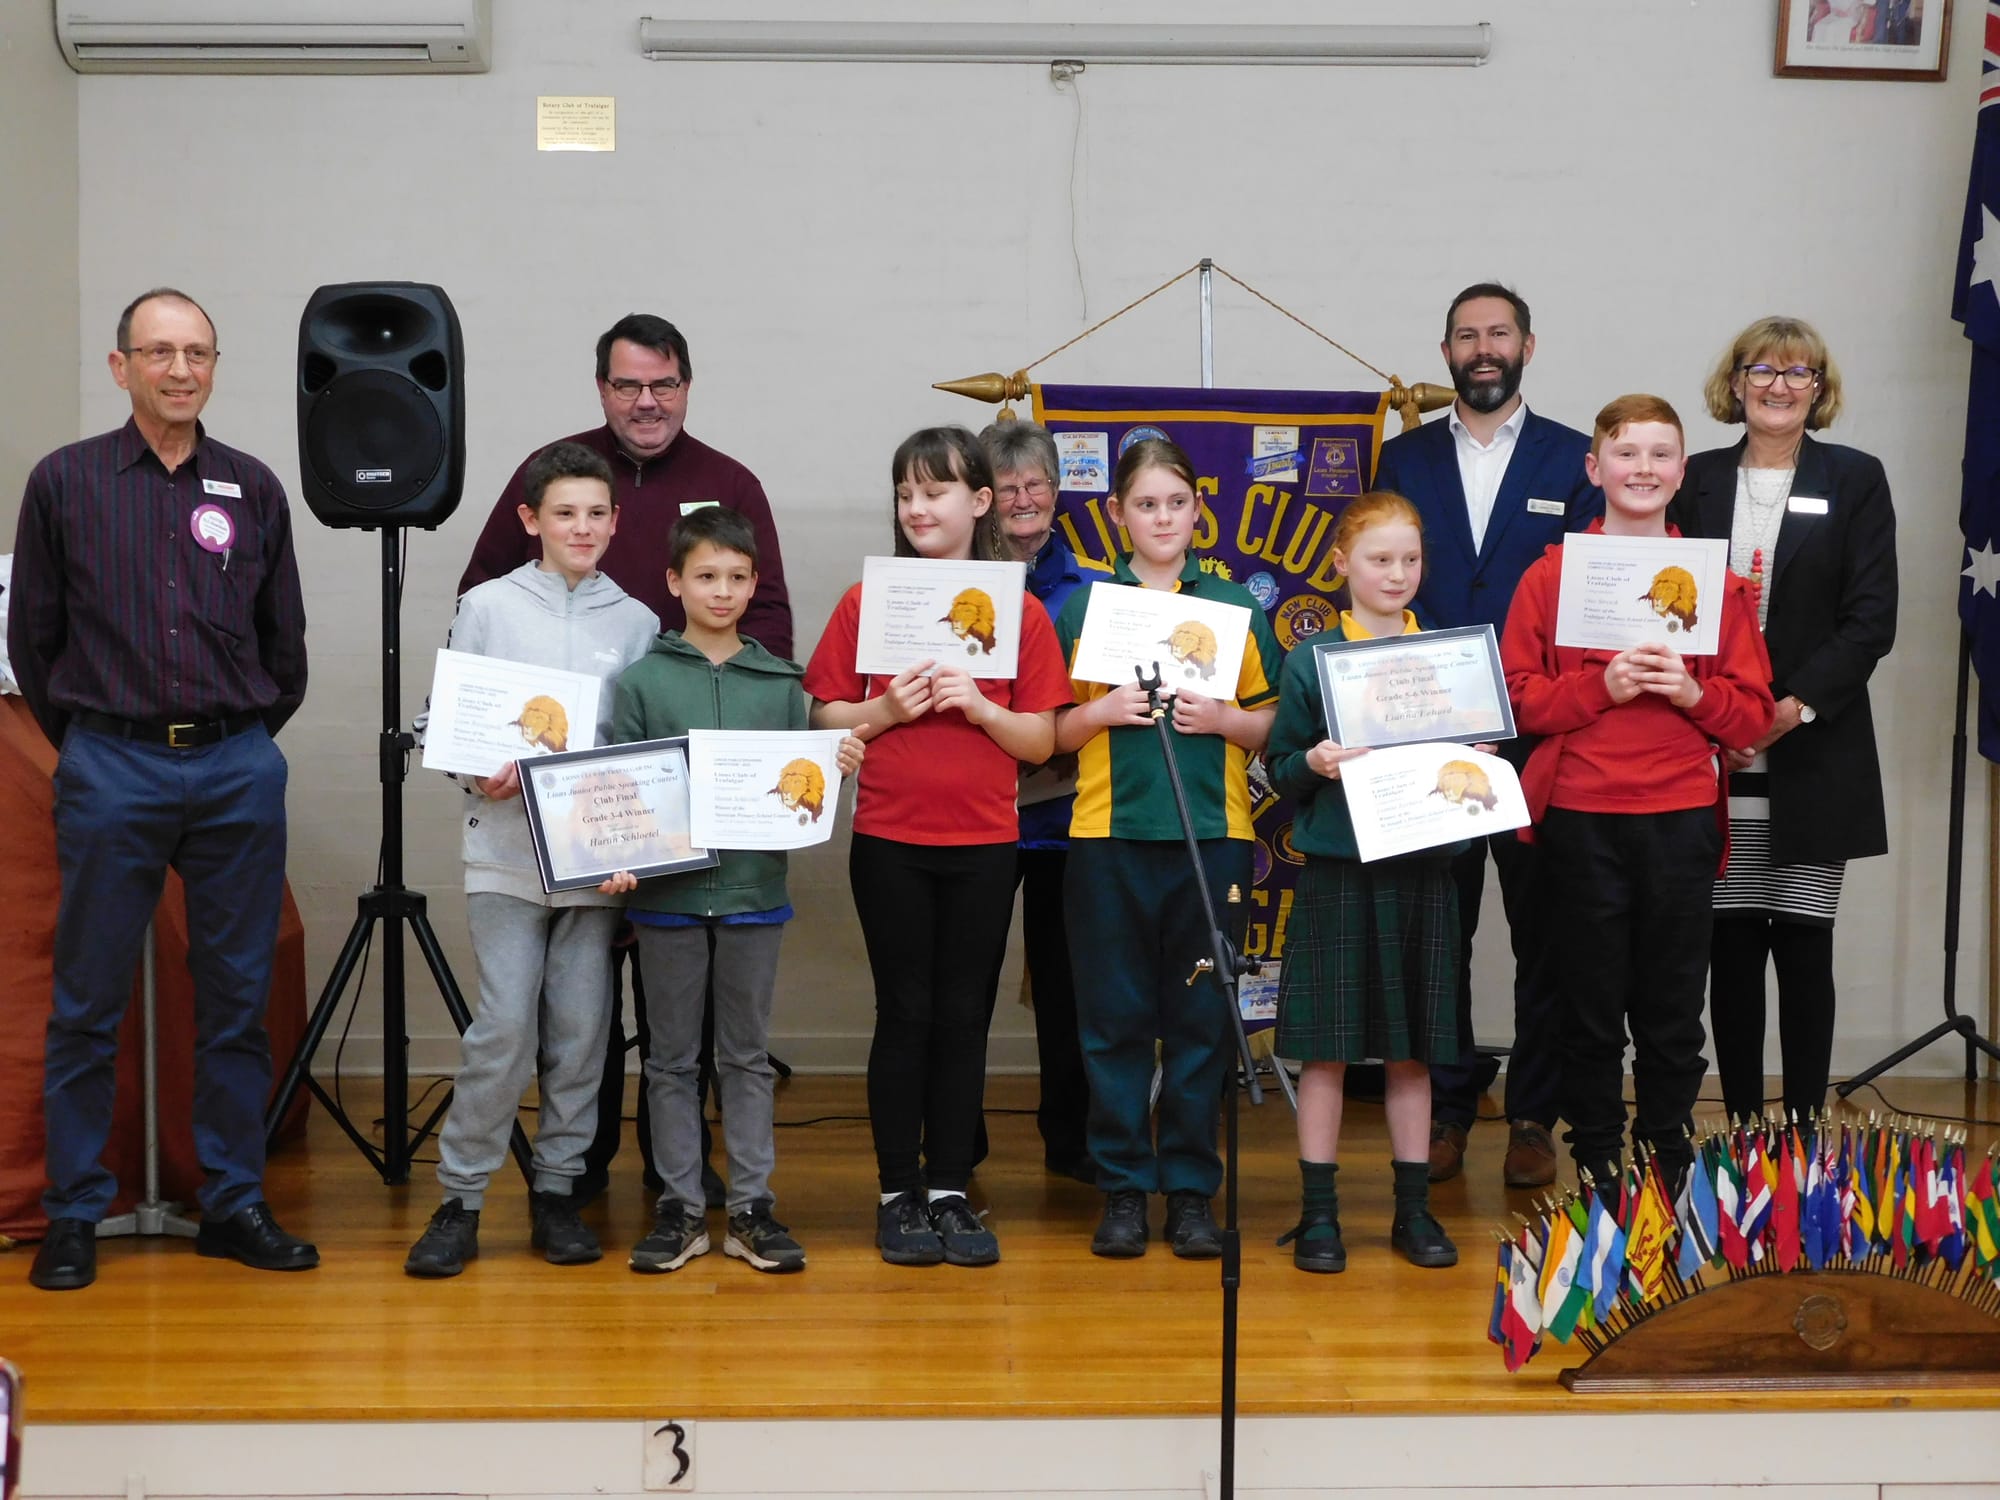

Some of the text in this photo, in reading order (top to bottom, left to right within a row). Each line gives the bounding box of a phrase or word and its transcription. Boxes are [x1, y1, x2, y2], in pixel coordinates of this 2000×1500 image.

[542, 102, 560, 110] Rotary
[584, 102, 609, 110] Trafalgar
[1067, 468, 1087, 476] TOP
[1280, 598, 1332, 620] NEW CLUB
[1389, 674, 1434, 686] Club Final
[1376, 688, 1452, 702] Grade 5-6 Winner
[562, 774, 578, 782] LIONS
[568, 787, 591, 796] Junior
[594, 784, 616, 792] Public
[618, 778, 650, 789] Speaking
[652, 775, 678, 784] Contest
[594, 792, 638, 805] Club Final
[582, 808, 656, 824] Grade 3-4 Winner
[654, 1423, 690, 1485] 3
